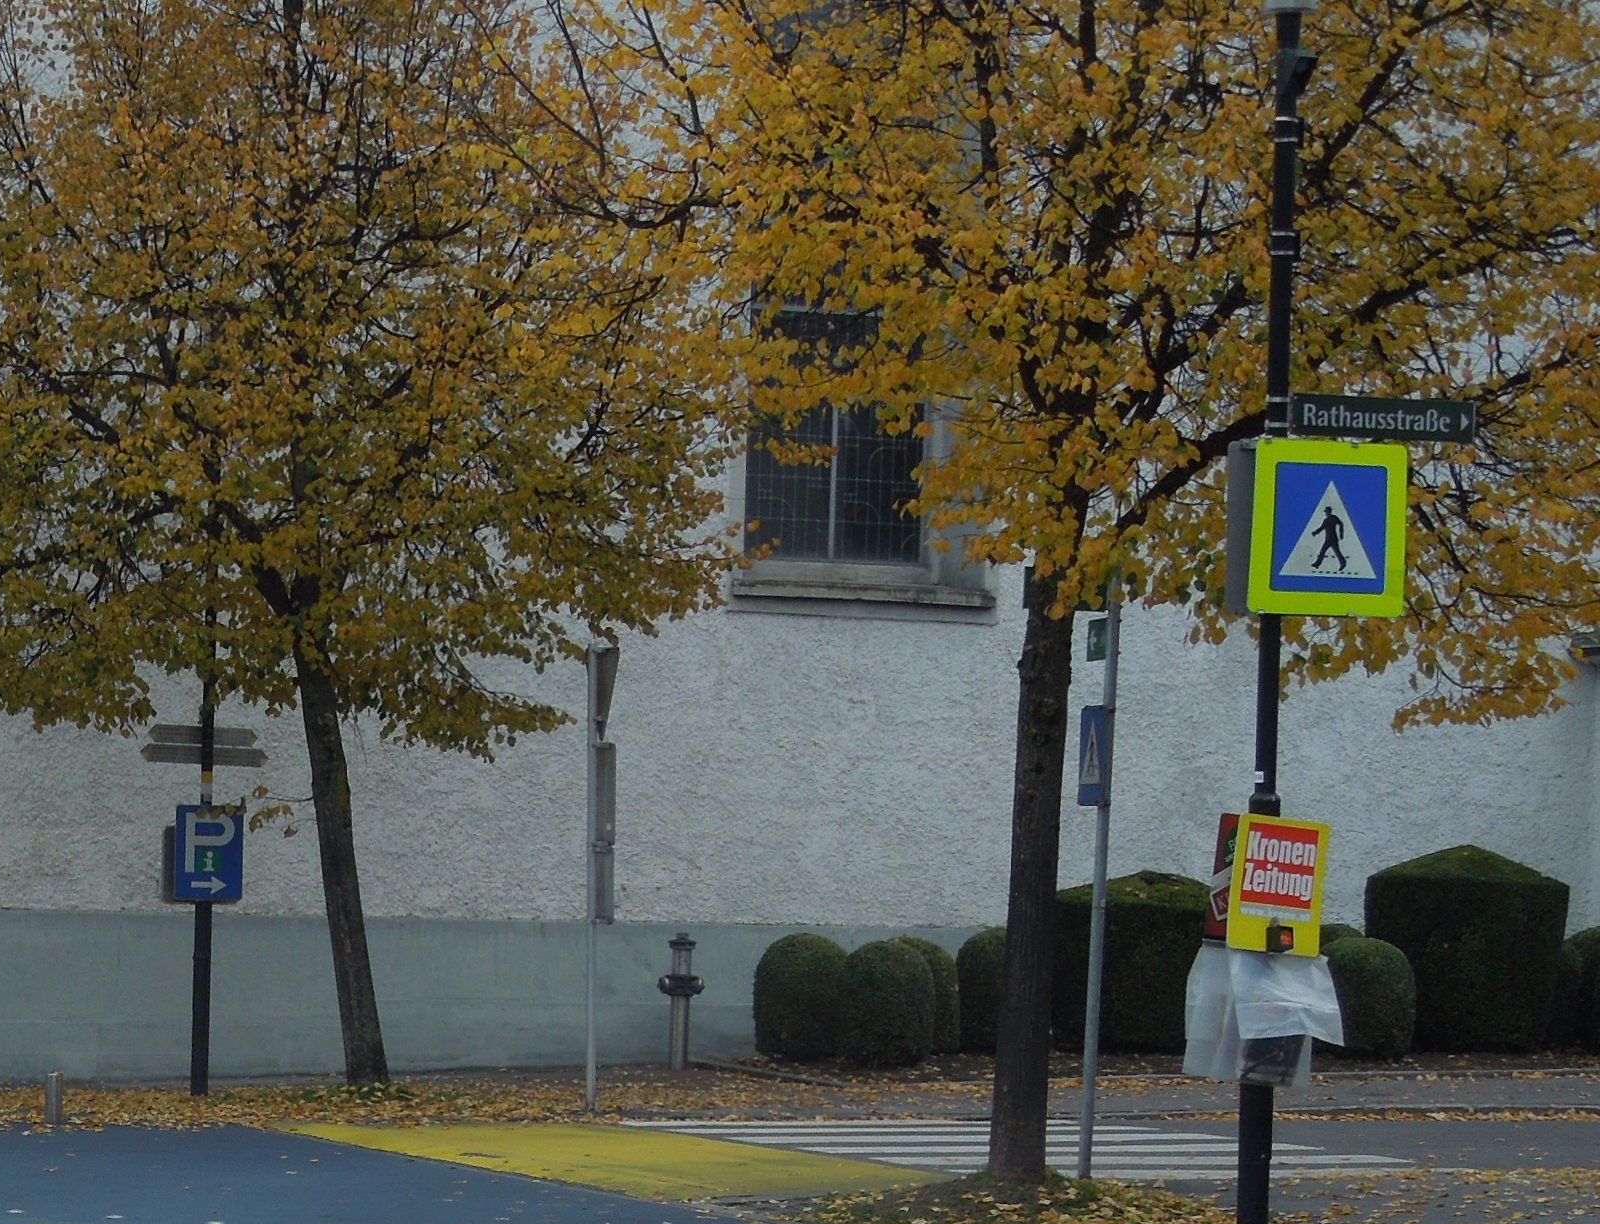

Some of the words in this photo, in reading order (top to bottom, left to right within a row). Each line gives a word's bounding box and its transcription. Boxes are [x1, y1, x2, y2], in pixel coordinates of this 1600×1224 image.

[1302, 403, 1450, 433] Rathausstraße
[185, 812, 235, 873] P
[1246, 831, 1317, 867] Kronen
[1242, 862, 1314, 902] Zeitung
